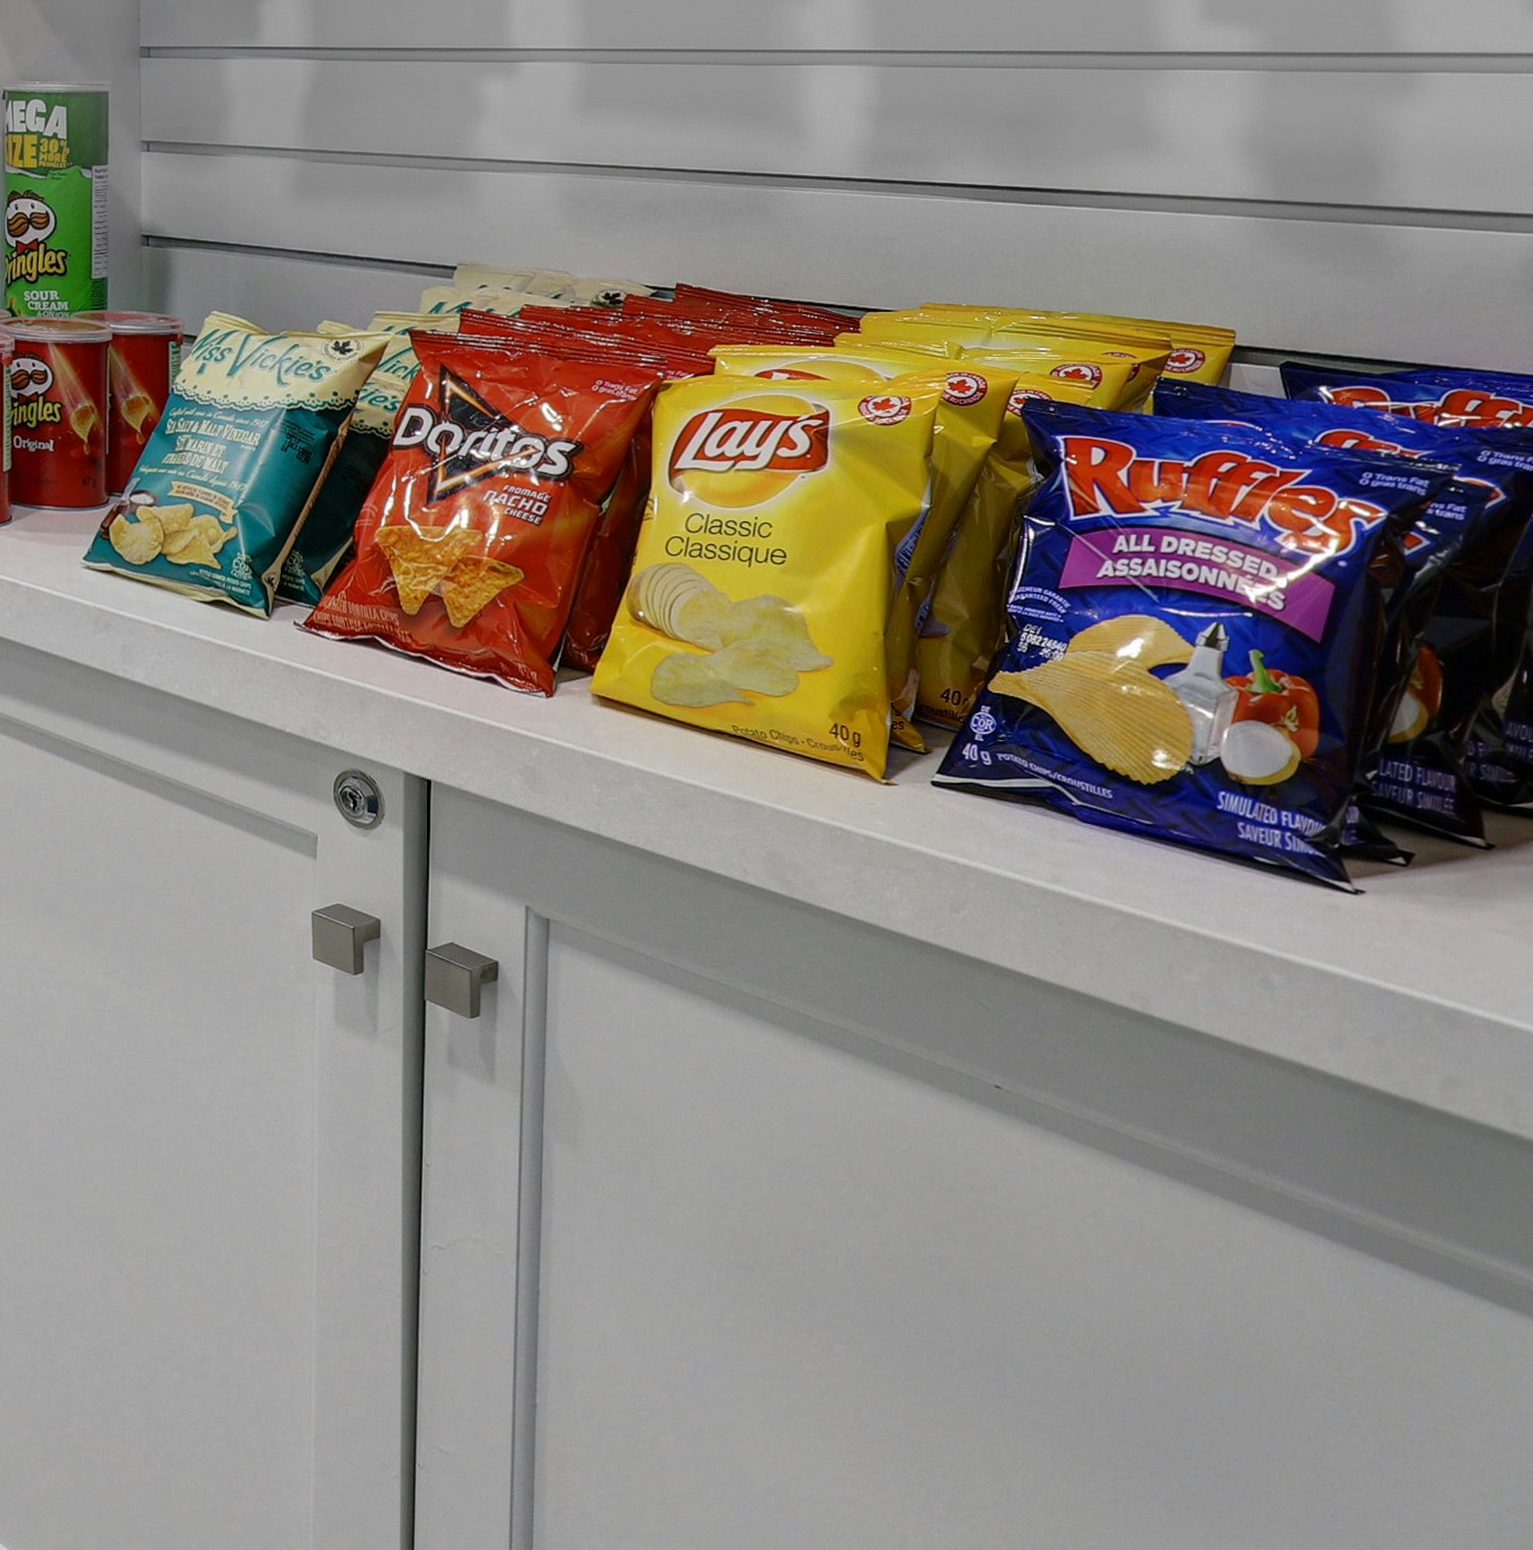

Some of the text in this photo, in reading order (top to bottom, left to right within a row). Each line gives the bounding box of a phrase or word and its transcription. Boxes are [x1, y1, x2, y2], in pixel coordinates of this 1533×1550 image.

[5, 134, 70, 168] IZE 30%
[39, 152, 67, 162] MORE
[24, 290, 59, 301] SOUR
[27, 300, 69, 311] CREAM
[192, 328, 332, 387] Miss Vickie's
[10, 396, 62, 430] ringles
[13, 435, 54, 453] Original
[201, 420, 222, 436] MALT
[224, 422, 261, 445] VINEGAR
[393, 407, 580, 479] Doritos
[675, 412, 824, 474] Lay's
[203, 456, 229, 473] MALT
[1370, 480, 1427, 496] gras trans
[1373, 472, 1429, 488] Trans Fat
[484, 491, 548, 515] NACHO
[503, 484, 551, 503] FROMAGE
[1060, 435, 1389, 558] Ruffles
[503, 508, 542, 525] CHEESE
[684, 512, 774, 539] Classic
[664, 535, 788, 568] Classique
[1113, 534, 1279, 581] ALL DRESSED
[972, 715, 993, 730] COR
[732, 724, 767, 740] Potato
[770, 729, 799, 746] Chips
[829, 723, 862, 748] 40 g
[962, 743, 992, 765] 40 g
[996, 752, 1029, 770] POTATO
[1416, 765, 1457, 793] FLAVOUR
[1217, 791, 1277, 826] SIMULATED
[1237, 822, 1283, 849] SAVEUR
